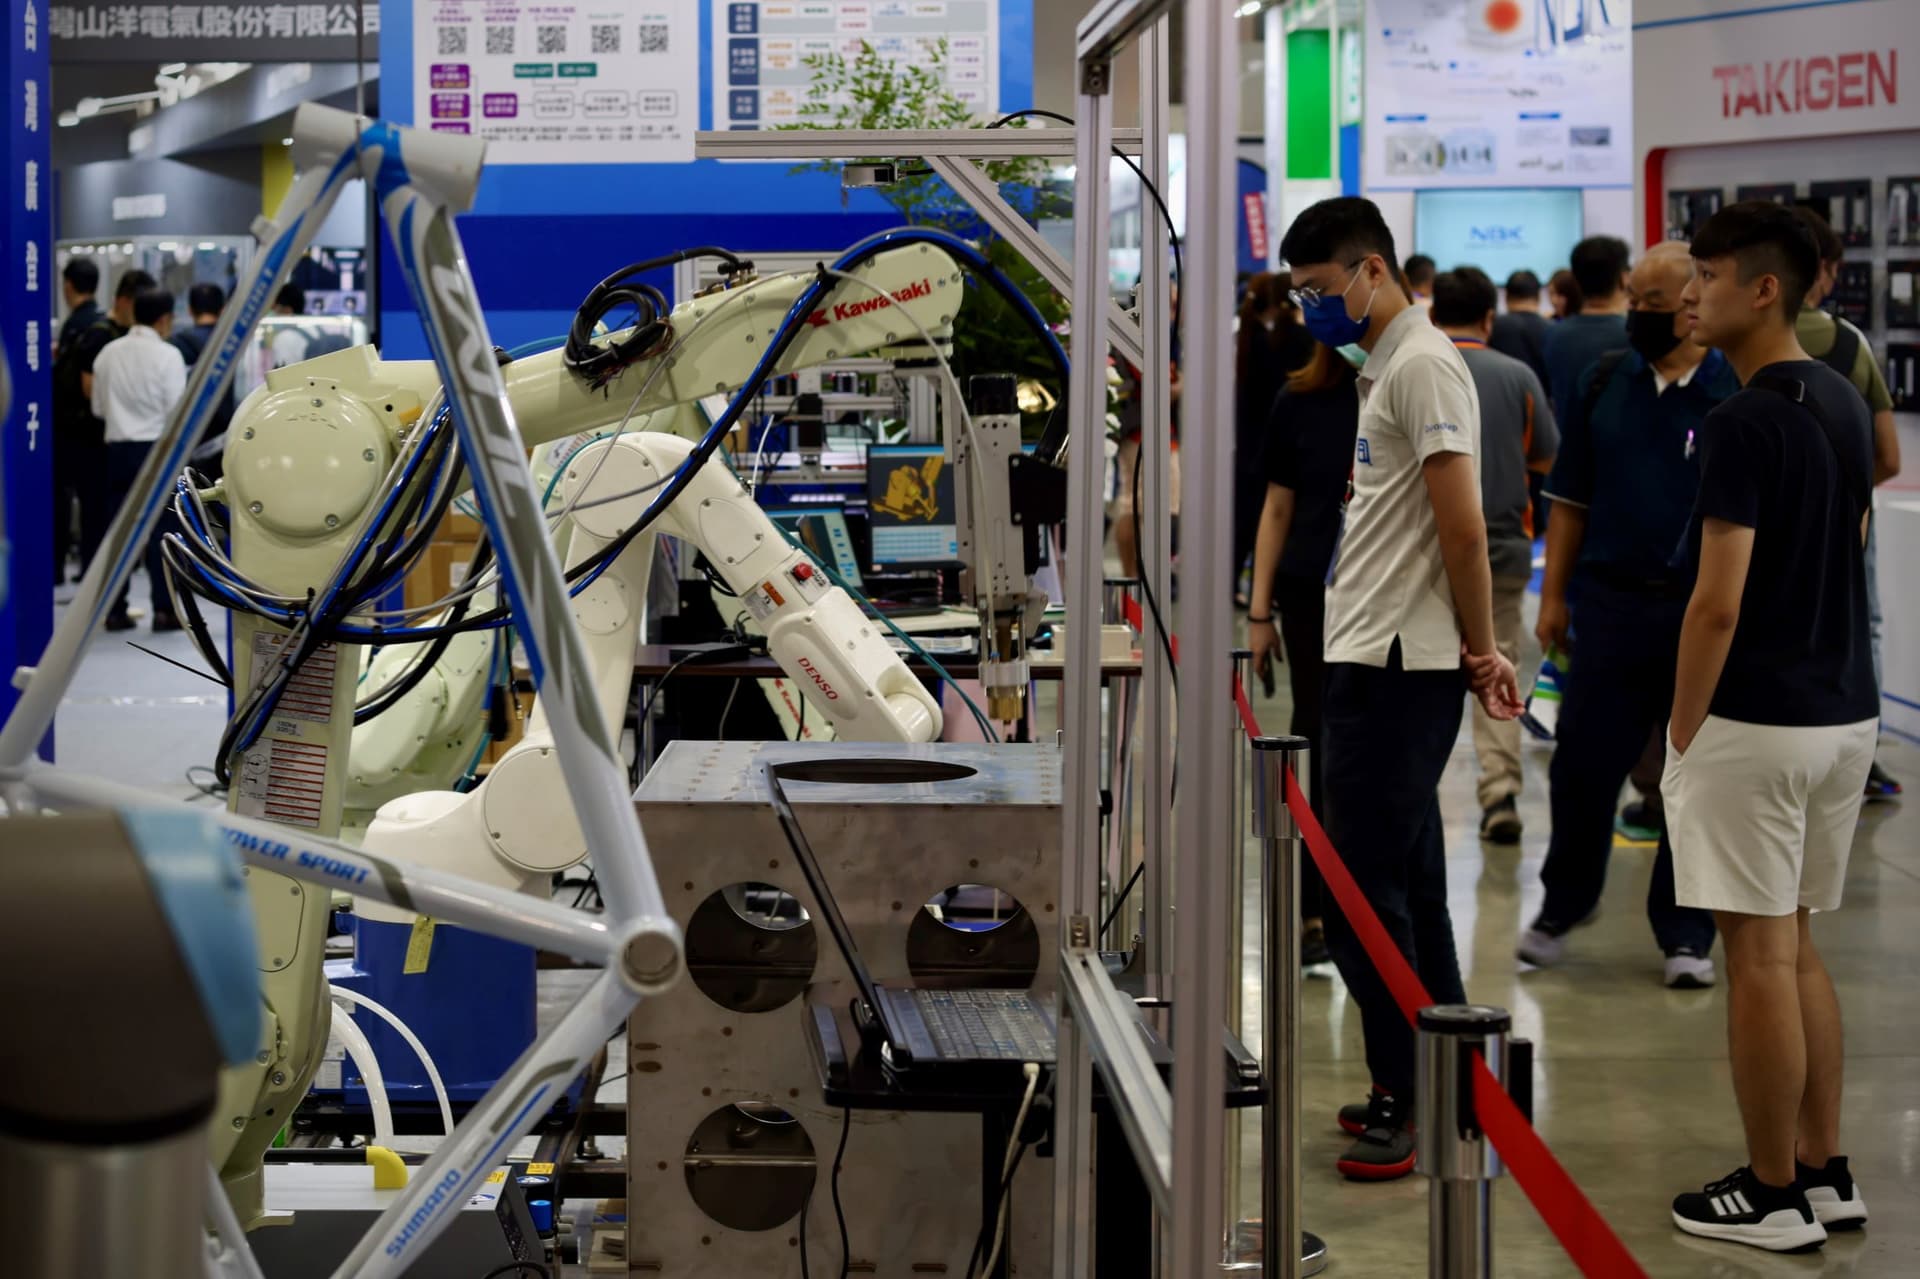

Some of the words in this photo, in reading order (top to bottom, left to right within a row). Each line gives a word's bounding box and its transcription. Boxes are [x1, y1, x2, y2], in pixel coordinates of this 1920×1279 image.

[1712, 49, 1897, 119] TAKIGEN
[798, 657, 839, 701] DENSO
[297, 850, 371, 884] SPORT
[385, 1168, 463, 1259] SHIMANO
